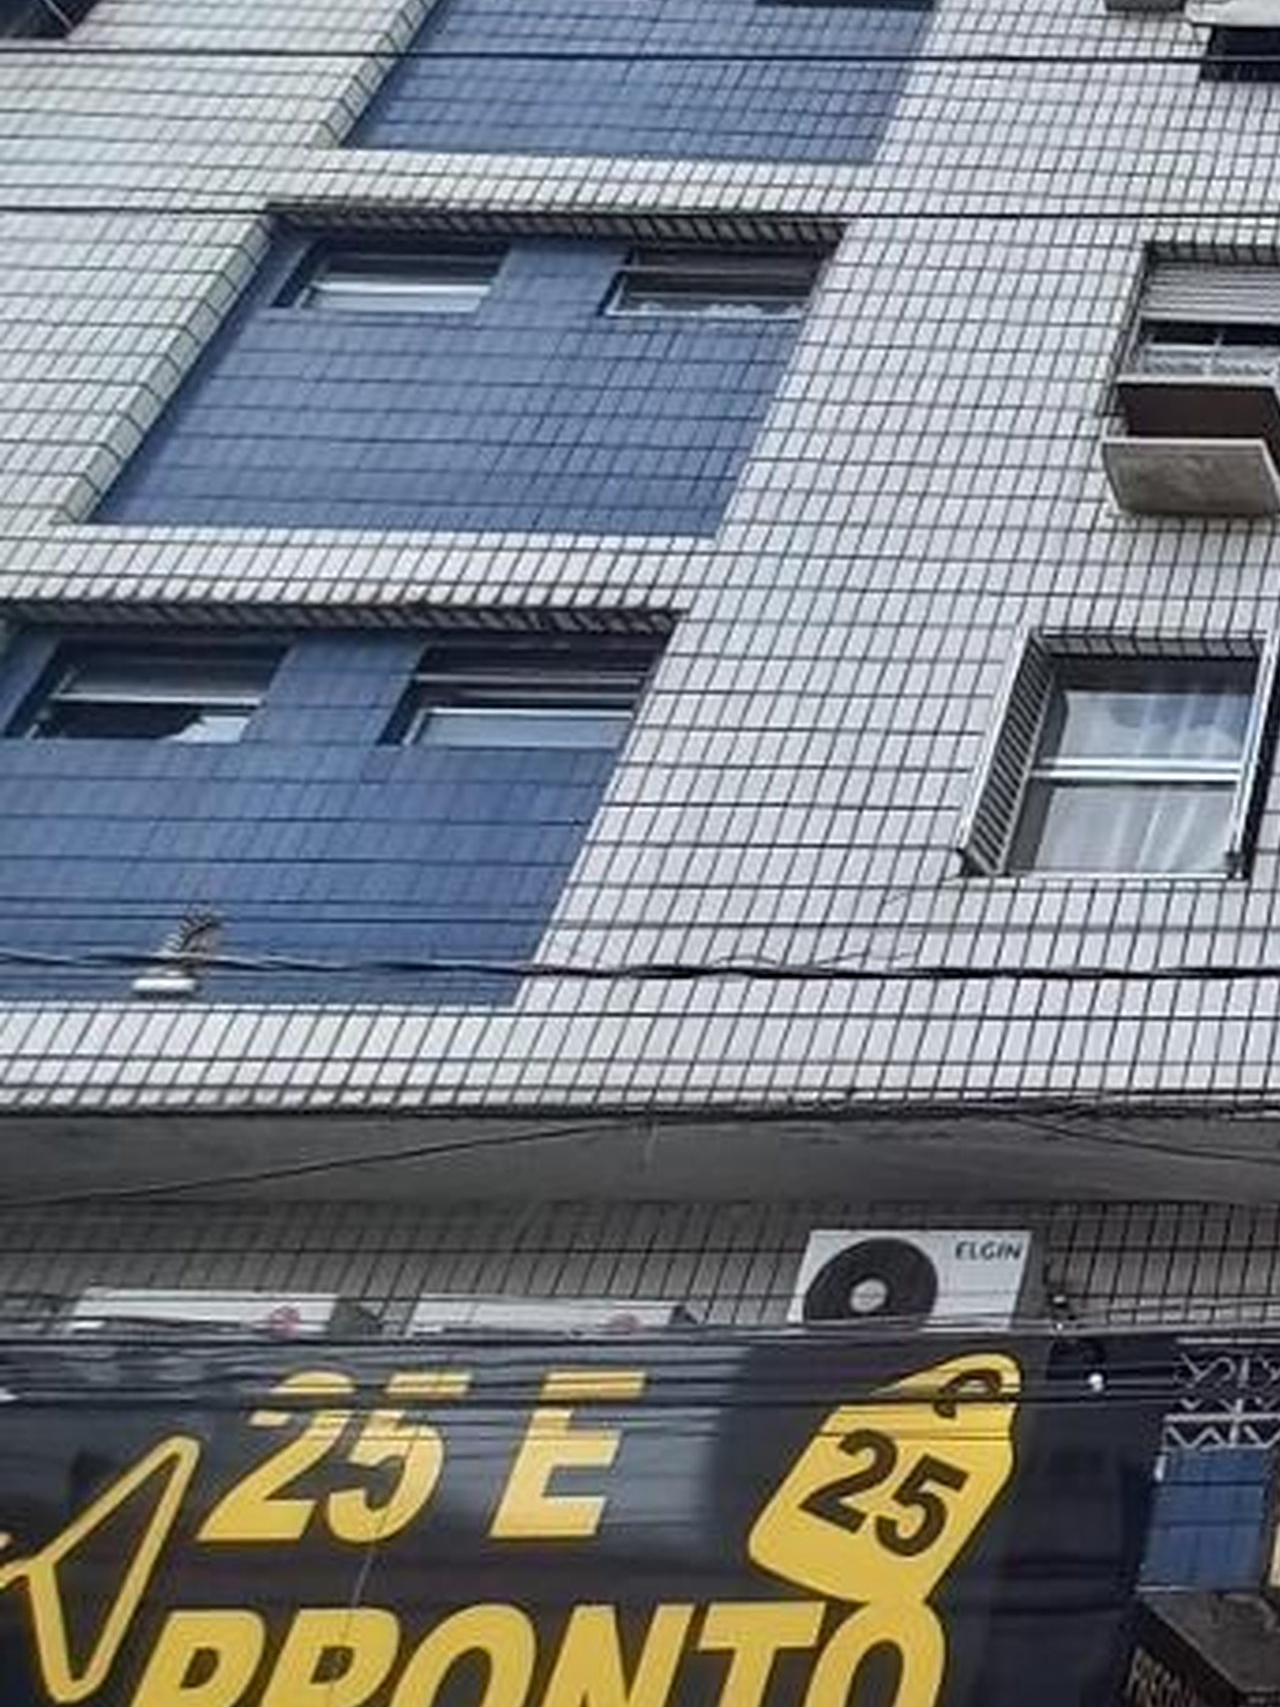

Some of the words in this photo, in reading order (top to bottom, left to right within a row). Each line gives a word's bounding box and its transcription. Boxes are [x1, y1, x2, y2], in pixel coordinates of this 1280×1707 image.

[954, 1240, 1023, 1261] ELGIN
[197, 1368, 472, 1544] 25
[489, 1370, 647, 1538] E
[801, 1429, 970, 1557] 25
